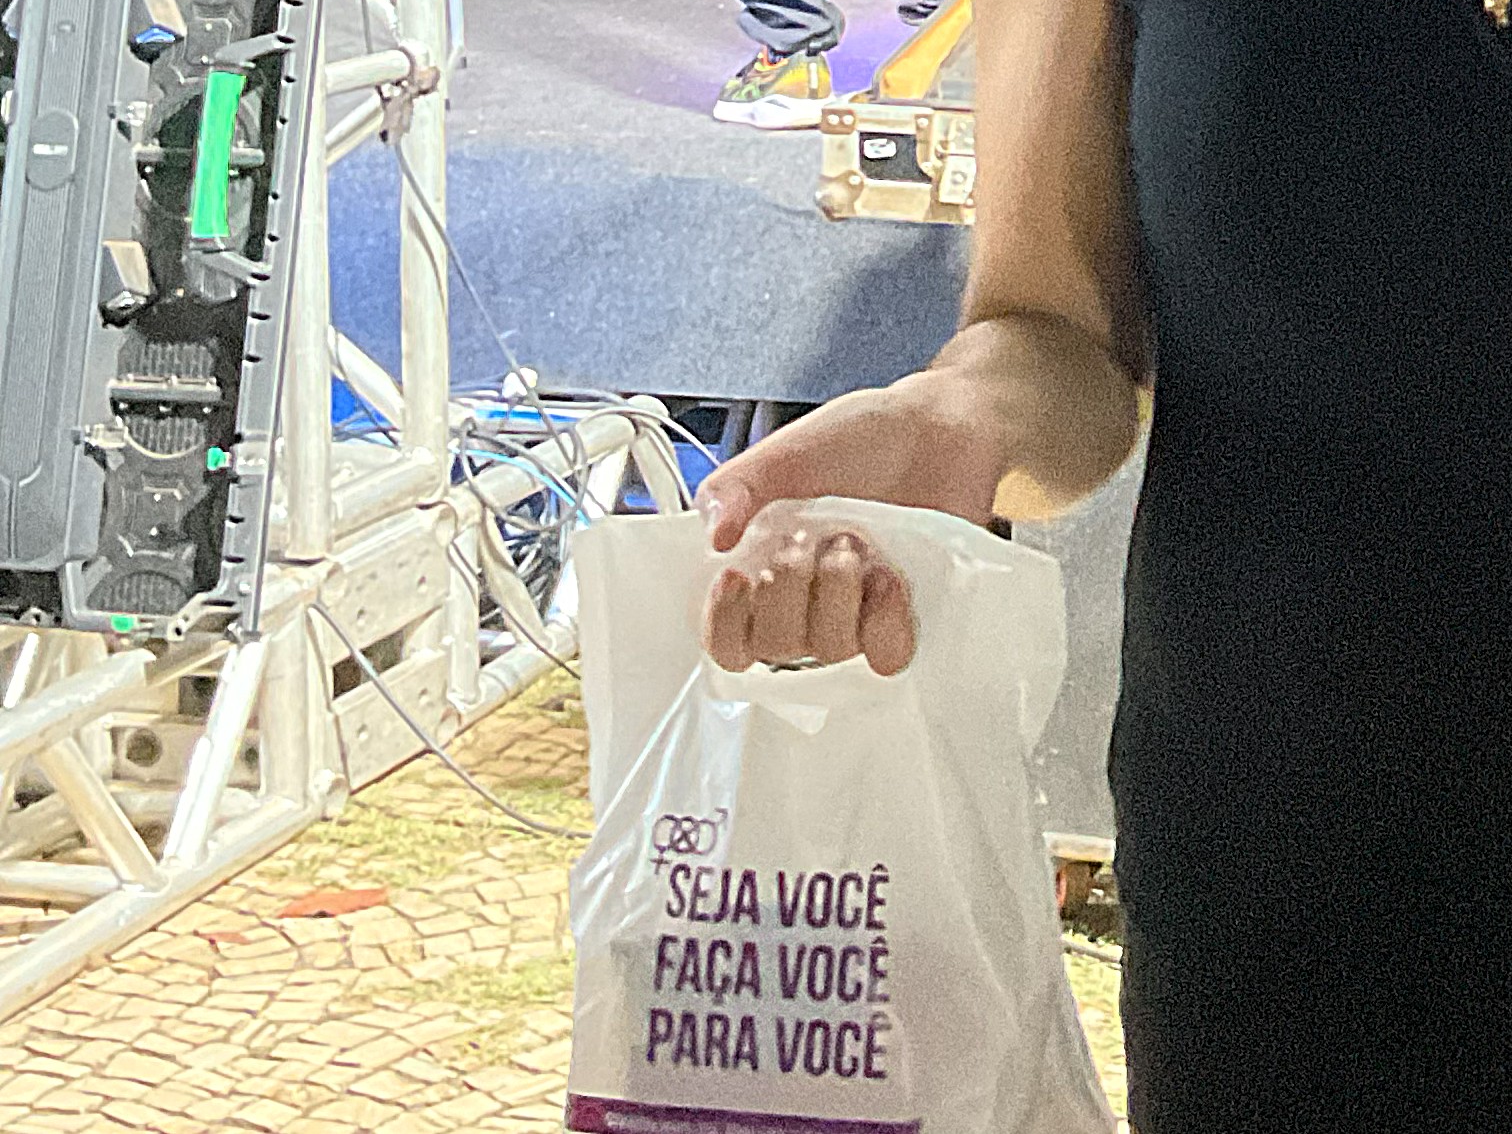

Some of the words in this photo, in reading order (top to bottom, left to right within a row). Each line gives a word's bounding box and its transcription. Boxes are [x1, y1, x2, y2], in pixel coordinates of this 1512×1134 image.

[665, 864, 761, 926] SEJA
[777, 864, 890, 931] VOCÊ
[653, 934, 762, 1004] FAÇA
[777, 937, 890, 1003] VOCÊ
[646, 1008, 760, 1071] PARA
[775, 1012, 891, 1079] VOCÊ
